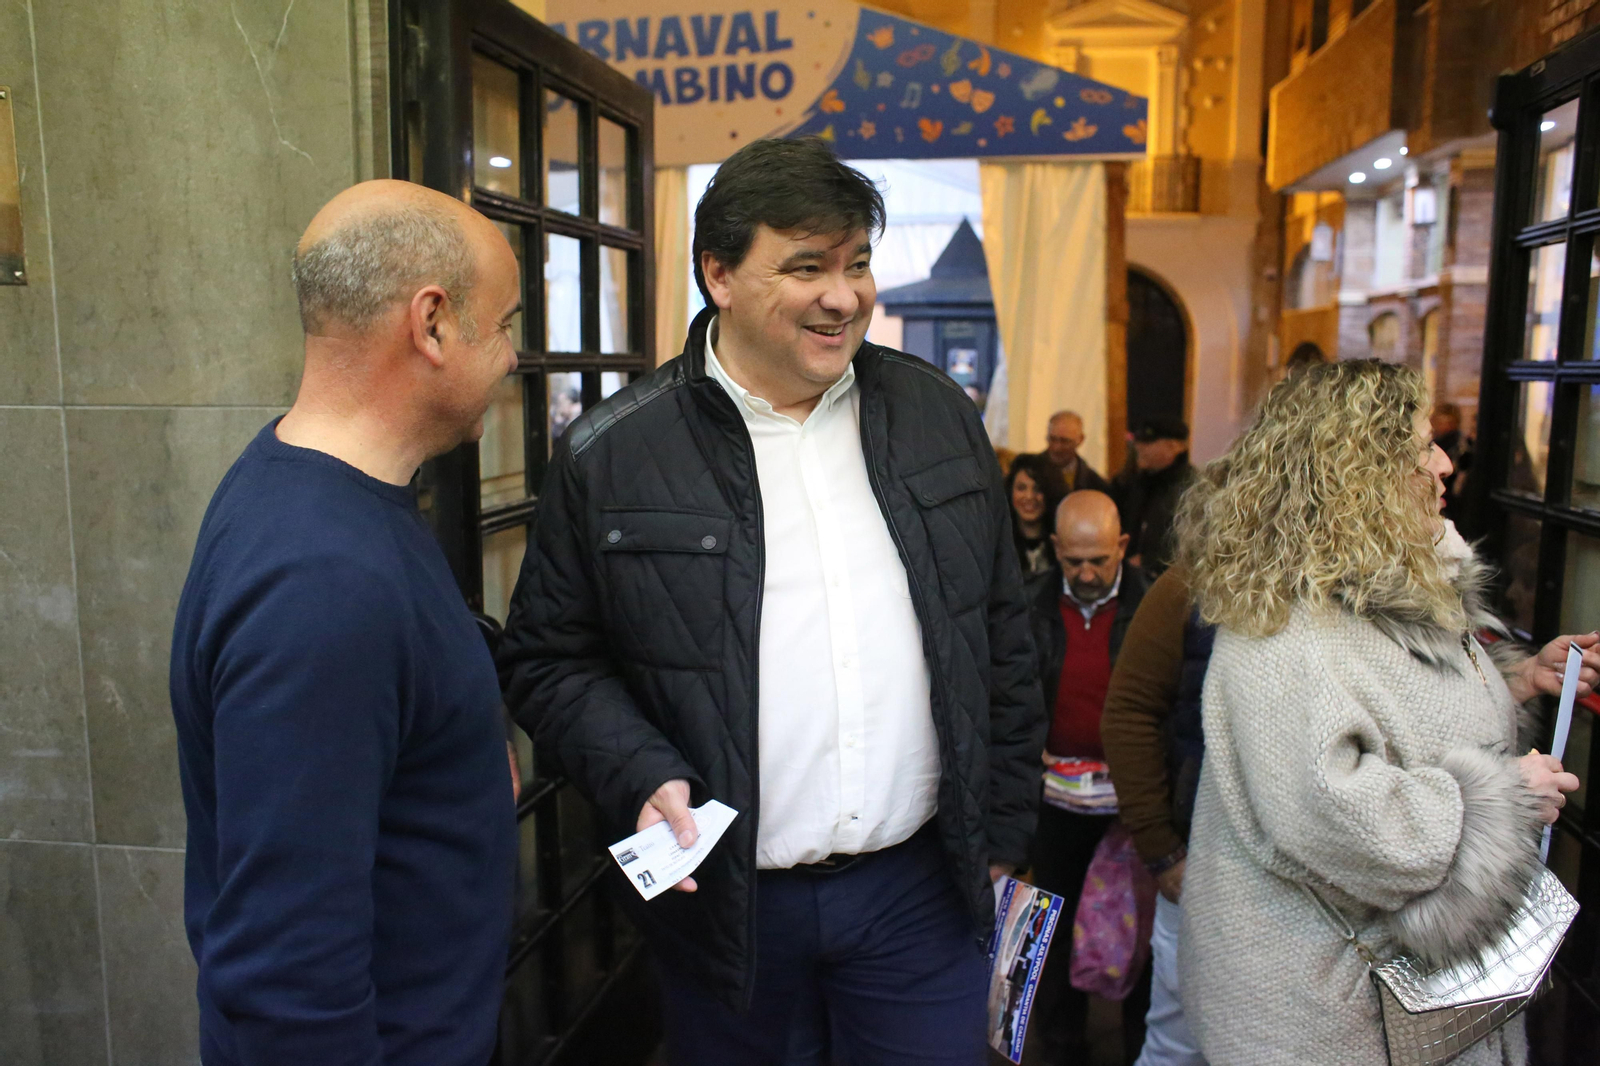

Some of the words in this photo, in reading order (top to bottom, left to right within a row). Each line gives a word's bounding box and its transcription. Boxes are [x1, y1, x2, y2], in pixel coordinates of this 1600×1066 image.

[637, 869, 657, 889] 27
[1042, 909, 1057, 943] PISCINAS
[1030, 943, 1045, 981] JULYPOOL
[1020, 1016, 1026, 1025] DE
[1015, 1026, 1024, 1053] CALIDAD
